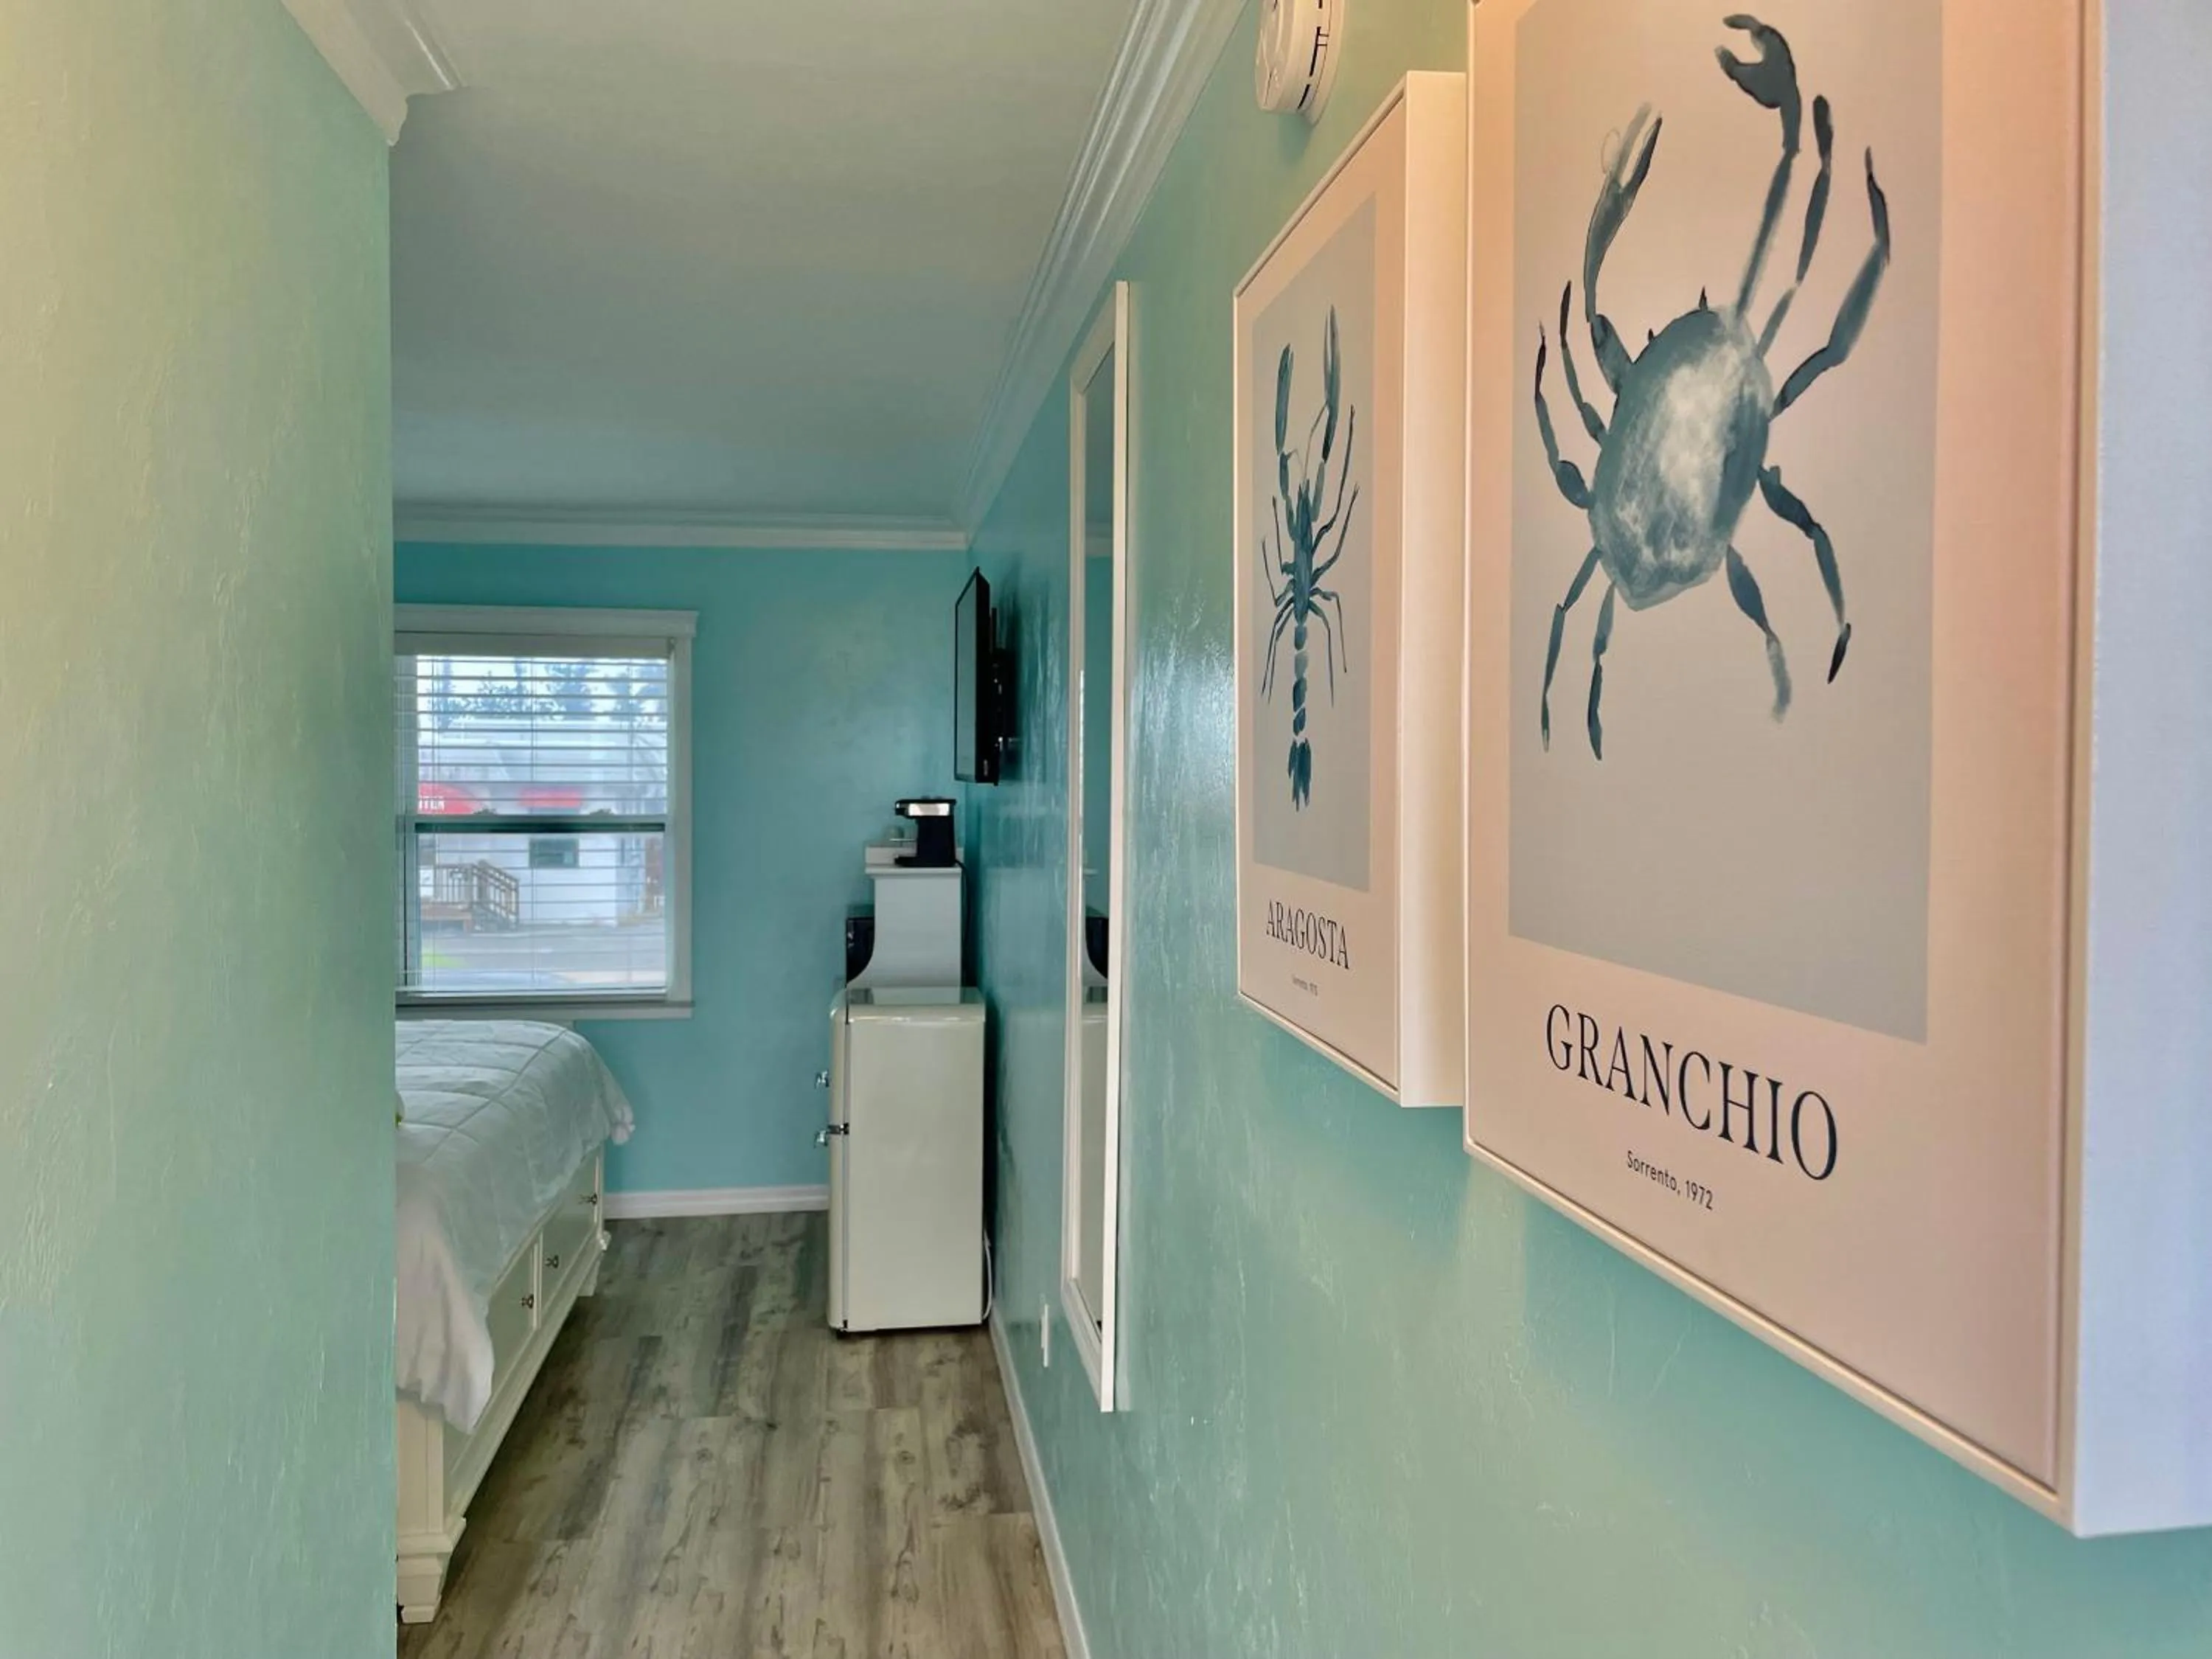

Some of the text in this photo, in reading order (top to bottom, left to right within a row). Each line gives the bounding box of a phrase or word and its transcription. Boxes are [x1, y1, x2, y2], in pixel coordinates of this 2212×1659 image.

[1265, 899, 1350, 970] ARAGOSTA
[1545, 1004, 1837, 1180] GRANCHIO
[1627, 1150, 1714, 1211] Sorrento, 1972
